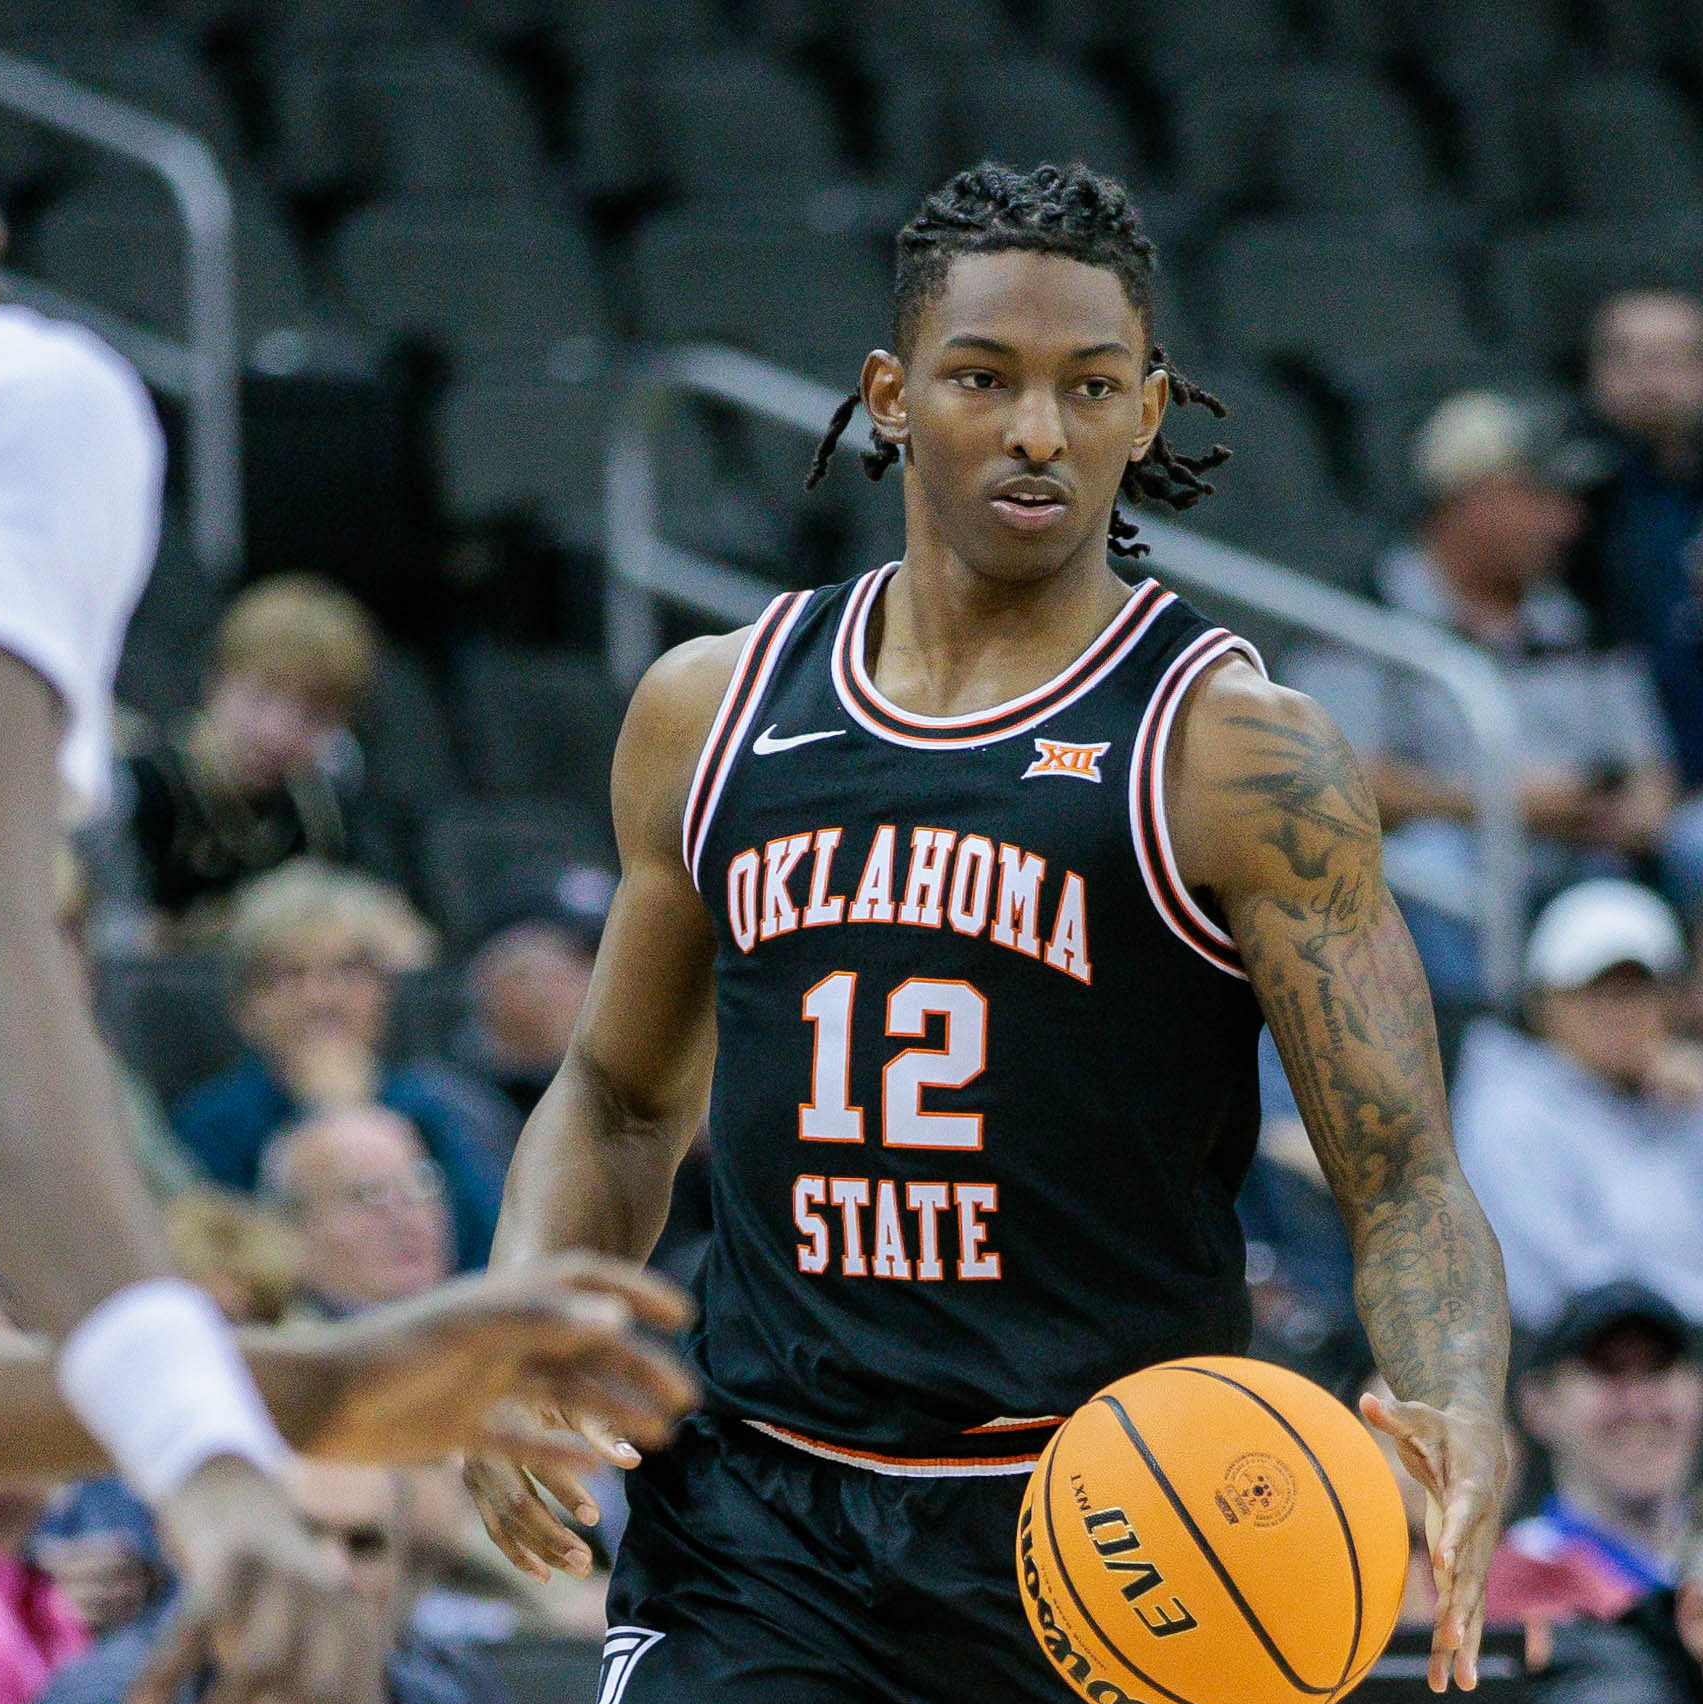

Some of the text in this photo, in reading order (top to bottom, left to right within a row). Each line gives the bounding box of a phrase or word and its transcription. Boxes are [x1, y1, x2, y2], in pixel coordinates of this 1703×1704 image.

[1027, 740, 1107, 780] XII
[727, 825, 1092, 985] OKLAHOMA
[799, 971, 988, 1151] 12
[794, 1175, 1002, 1282] STATE
[1070, 1473, 1093, 1511] NXT
[1082, 1505, 1199, 1639] EVO
